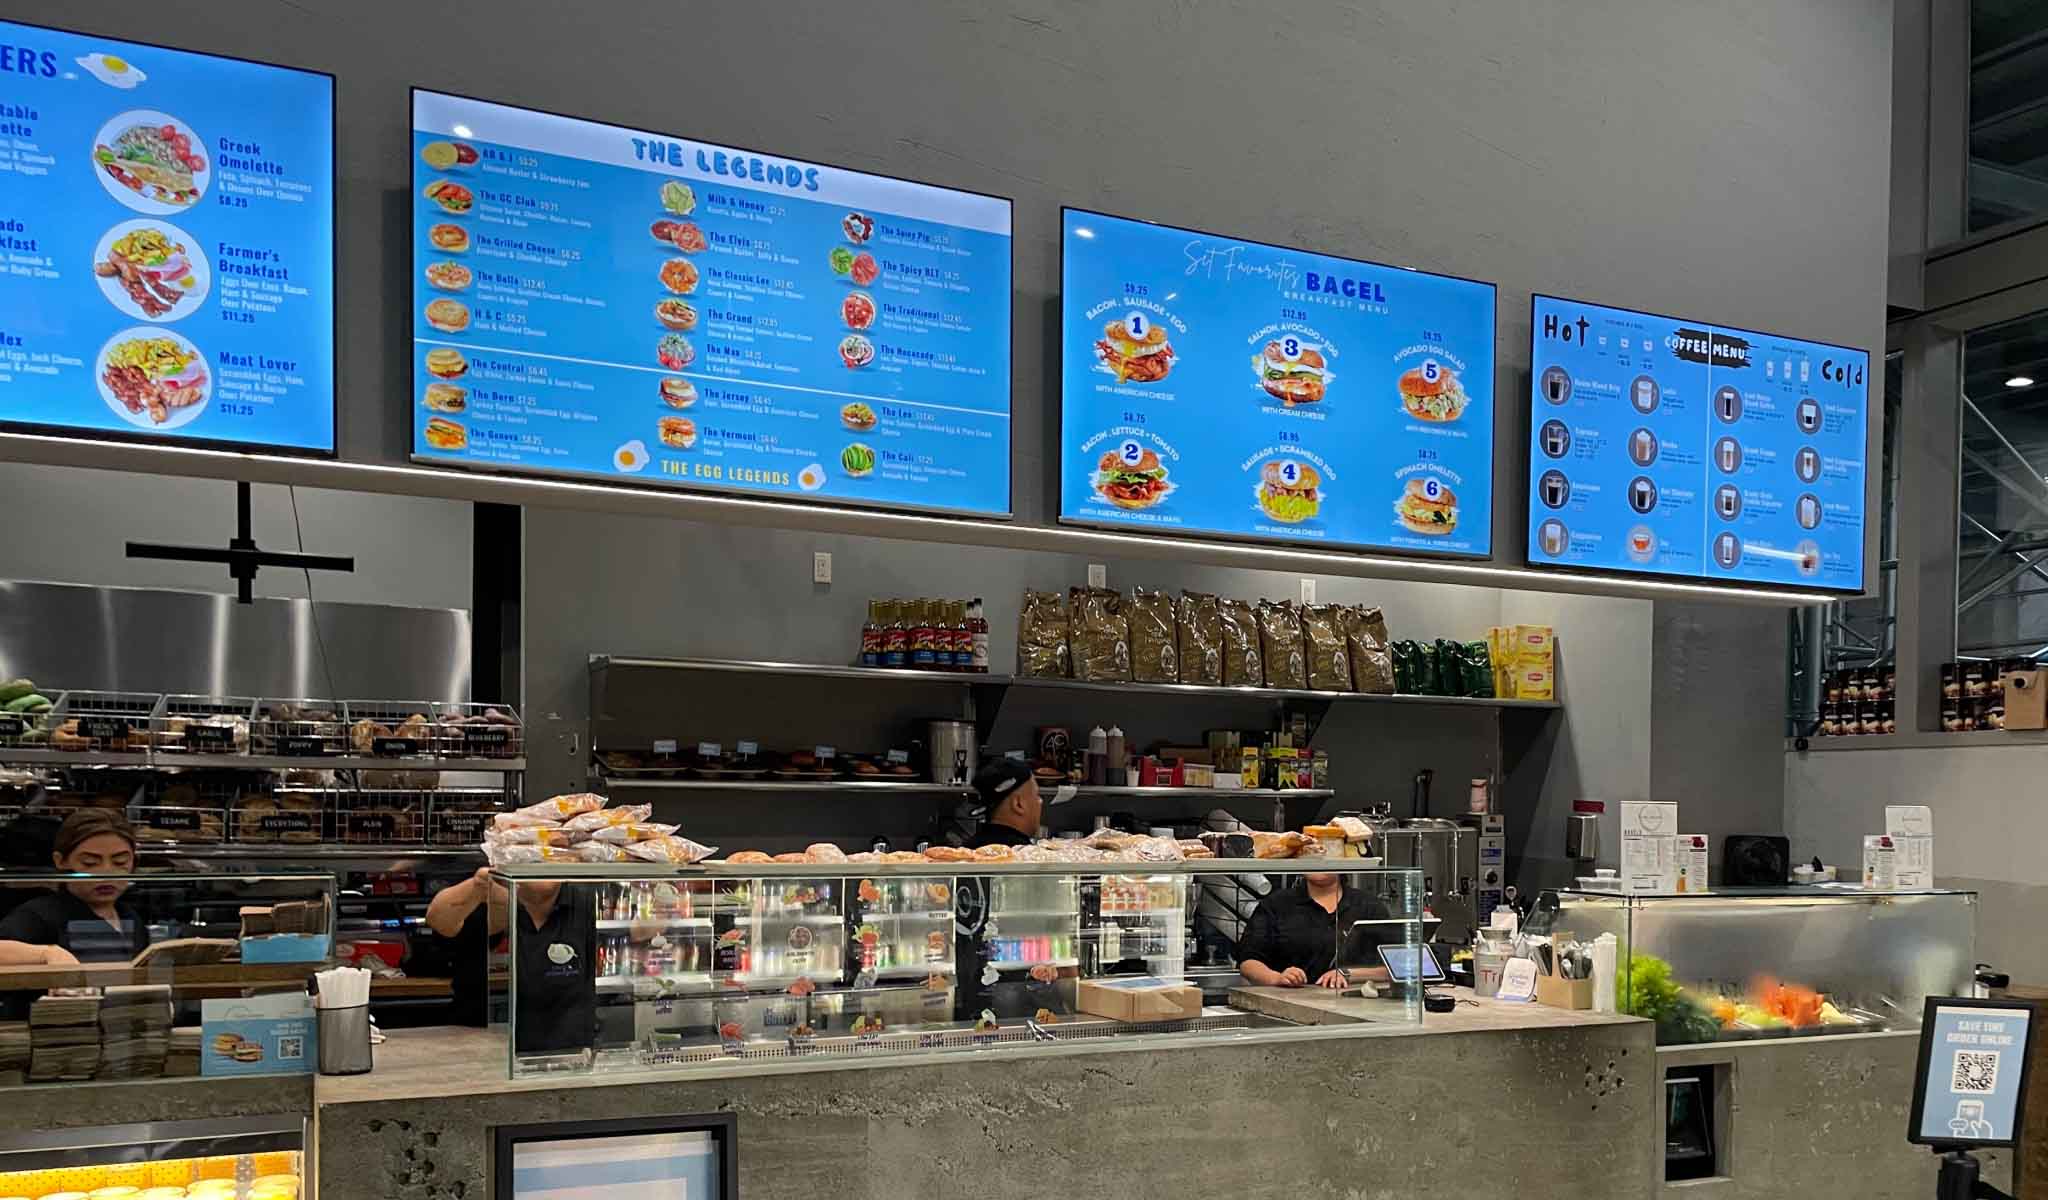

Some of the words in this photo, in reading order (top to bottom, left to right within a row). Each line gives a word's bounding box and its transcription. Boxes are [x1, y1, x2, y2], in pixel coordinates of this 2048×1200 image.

[0, 44, 57, 78] ERS
[219, 137, 260, 155] Greek
[219, 153, 283, 175] Omelette
[631, 138, 684, 168] THE
[696, 149, 820, 192] LEGENDS
[738, 199, 765, 213] Honey
[710, 231, 726, 243] The
[881, 225, 894, 235] The
[219, 242, 280, 262] Farmer's
[526, 240, 556, 255] Cheese
[219, 258, 288, 280] Breakfast
[708, 266, 722, 278] The
[725, 269, 753, 283] Classic
[883, 260, 897, 271] The
[899, 263, 922, 277] Spicy
[1306, 271, 1387, 304] BAGEL
[1284, 290, 1353, 309] BREAKFAST
[1358, 298, 1390, 315] MENU
[708, 308, 723, 320] The
[884, 303, 897, 313] The
[899, 305, 940, 321] Traditional
[1086, 298, 1117, 321] BACON
[1123, 296, 1165, 317] SAUSAGE
[1169, 312, 1188, 334] EGG
[1132, 316, 1143, 335] 1
[1281, 322, 1320, 342] AVOCADO
[1544, 314, 1590, 347] Hot
[706, 343, 721, 354] The
[881, 344, 895, 355] The
[1284, 339, 1299, 357] 3
[1393, 343, 1428, 363] AVOCADO
[1664, 335, 1707, 355] COFFEE
[1713, 343, 1746, 360] MENU
[220, 351, 254, 367] Meat
[259, 355, 296, 371] Lover
[472, 358, 487, 369] The
[490, 360, 524, 373] Central
[1425, 363, 1438, 379] 5
[1822, 359, 1863, 389] Cold
[472, 389, 488, 400] The
[704, 387, 719, 398] The
[722, 390, 749, 403] Jersey
[882, 407, 896, 417] The
[470, 428, 485, 438] The
[704, 426, 717, 437] The
[720, 428, 756, 441] Vermont
[1081, 430, 1107, 453] BACON
[1111, 426, 1145, 438] LETTUCE
[1150, 432, 1180, 462] TOMATO
[1124, 443, 1139, 461] 2
[882, 450, 896, 461] The
[661, 459, 689, 476] THE
[695, 462, 723, 479] EGG
[728, 464, 791, 486] LEGENDS
[1282, 463, 1297, 480] 4
[1394, 463, 1427, 480] SPINACH
[1426, 481, 1439, 496] 6
